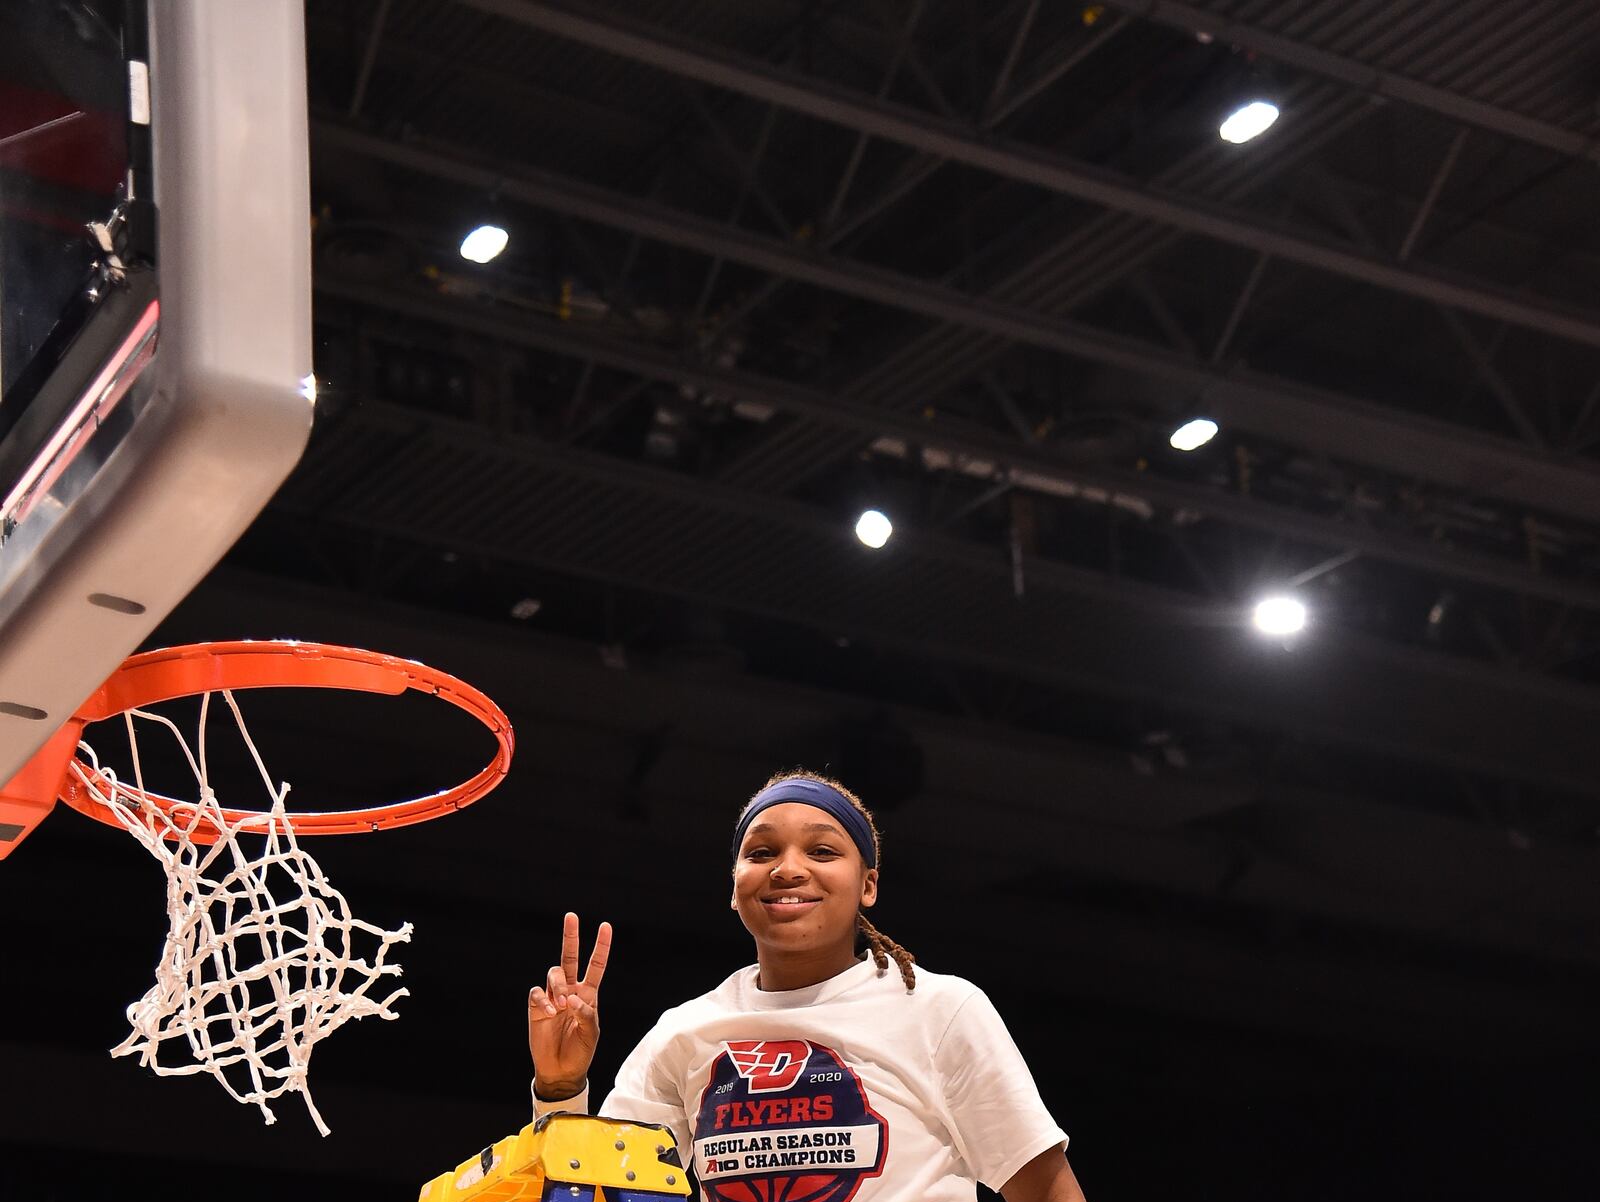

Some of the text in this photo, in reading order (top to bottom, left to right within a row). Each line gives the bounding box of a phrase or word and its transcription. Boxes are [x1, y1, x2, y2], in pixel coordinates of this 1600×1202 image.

[715, 1072, 842, 1095] 2019 2020
[714, 1094, 834, 1130] FLYERS
[703, 1132, 852, 1158] REGULAR SEASON
[705, 1149, 856, 1175] A10 CHAMPIONS
